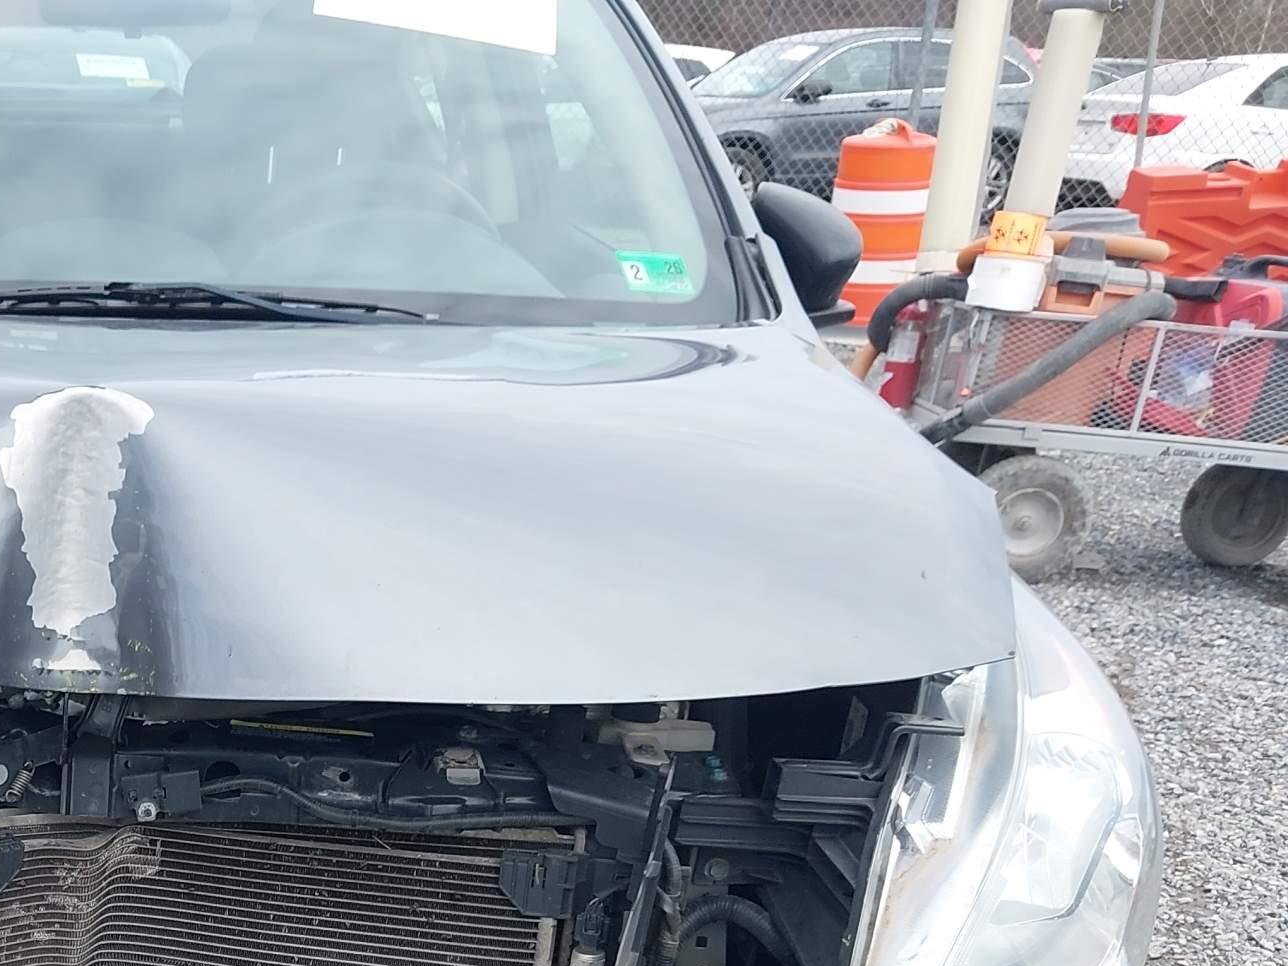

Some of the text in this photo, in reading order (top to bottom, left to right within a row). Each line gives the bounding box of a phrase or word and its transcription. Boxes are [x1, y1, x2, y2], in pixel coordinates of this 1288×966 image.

[630, 264, 643, 281] 2
[1172, 448, 1253, 463] GORILLA CARTS
